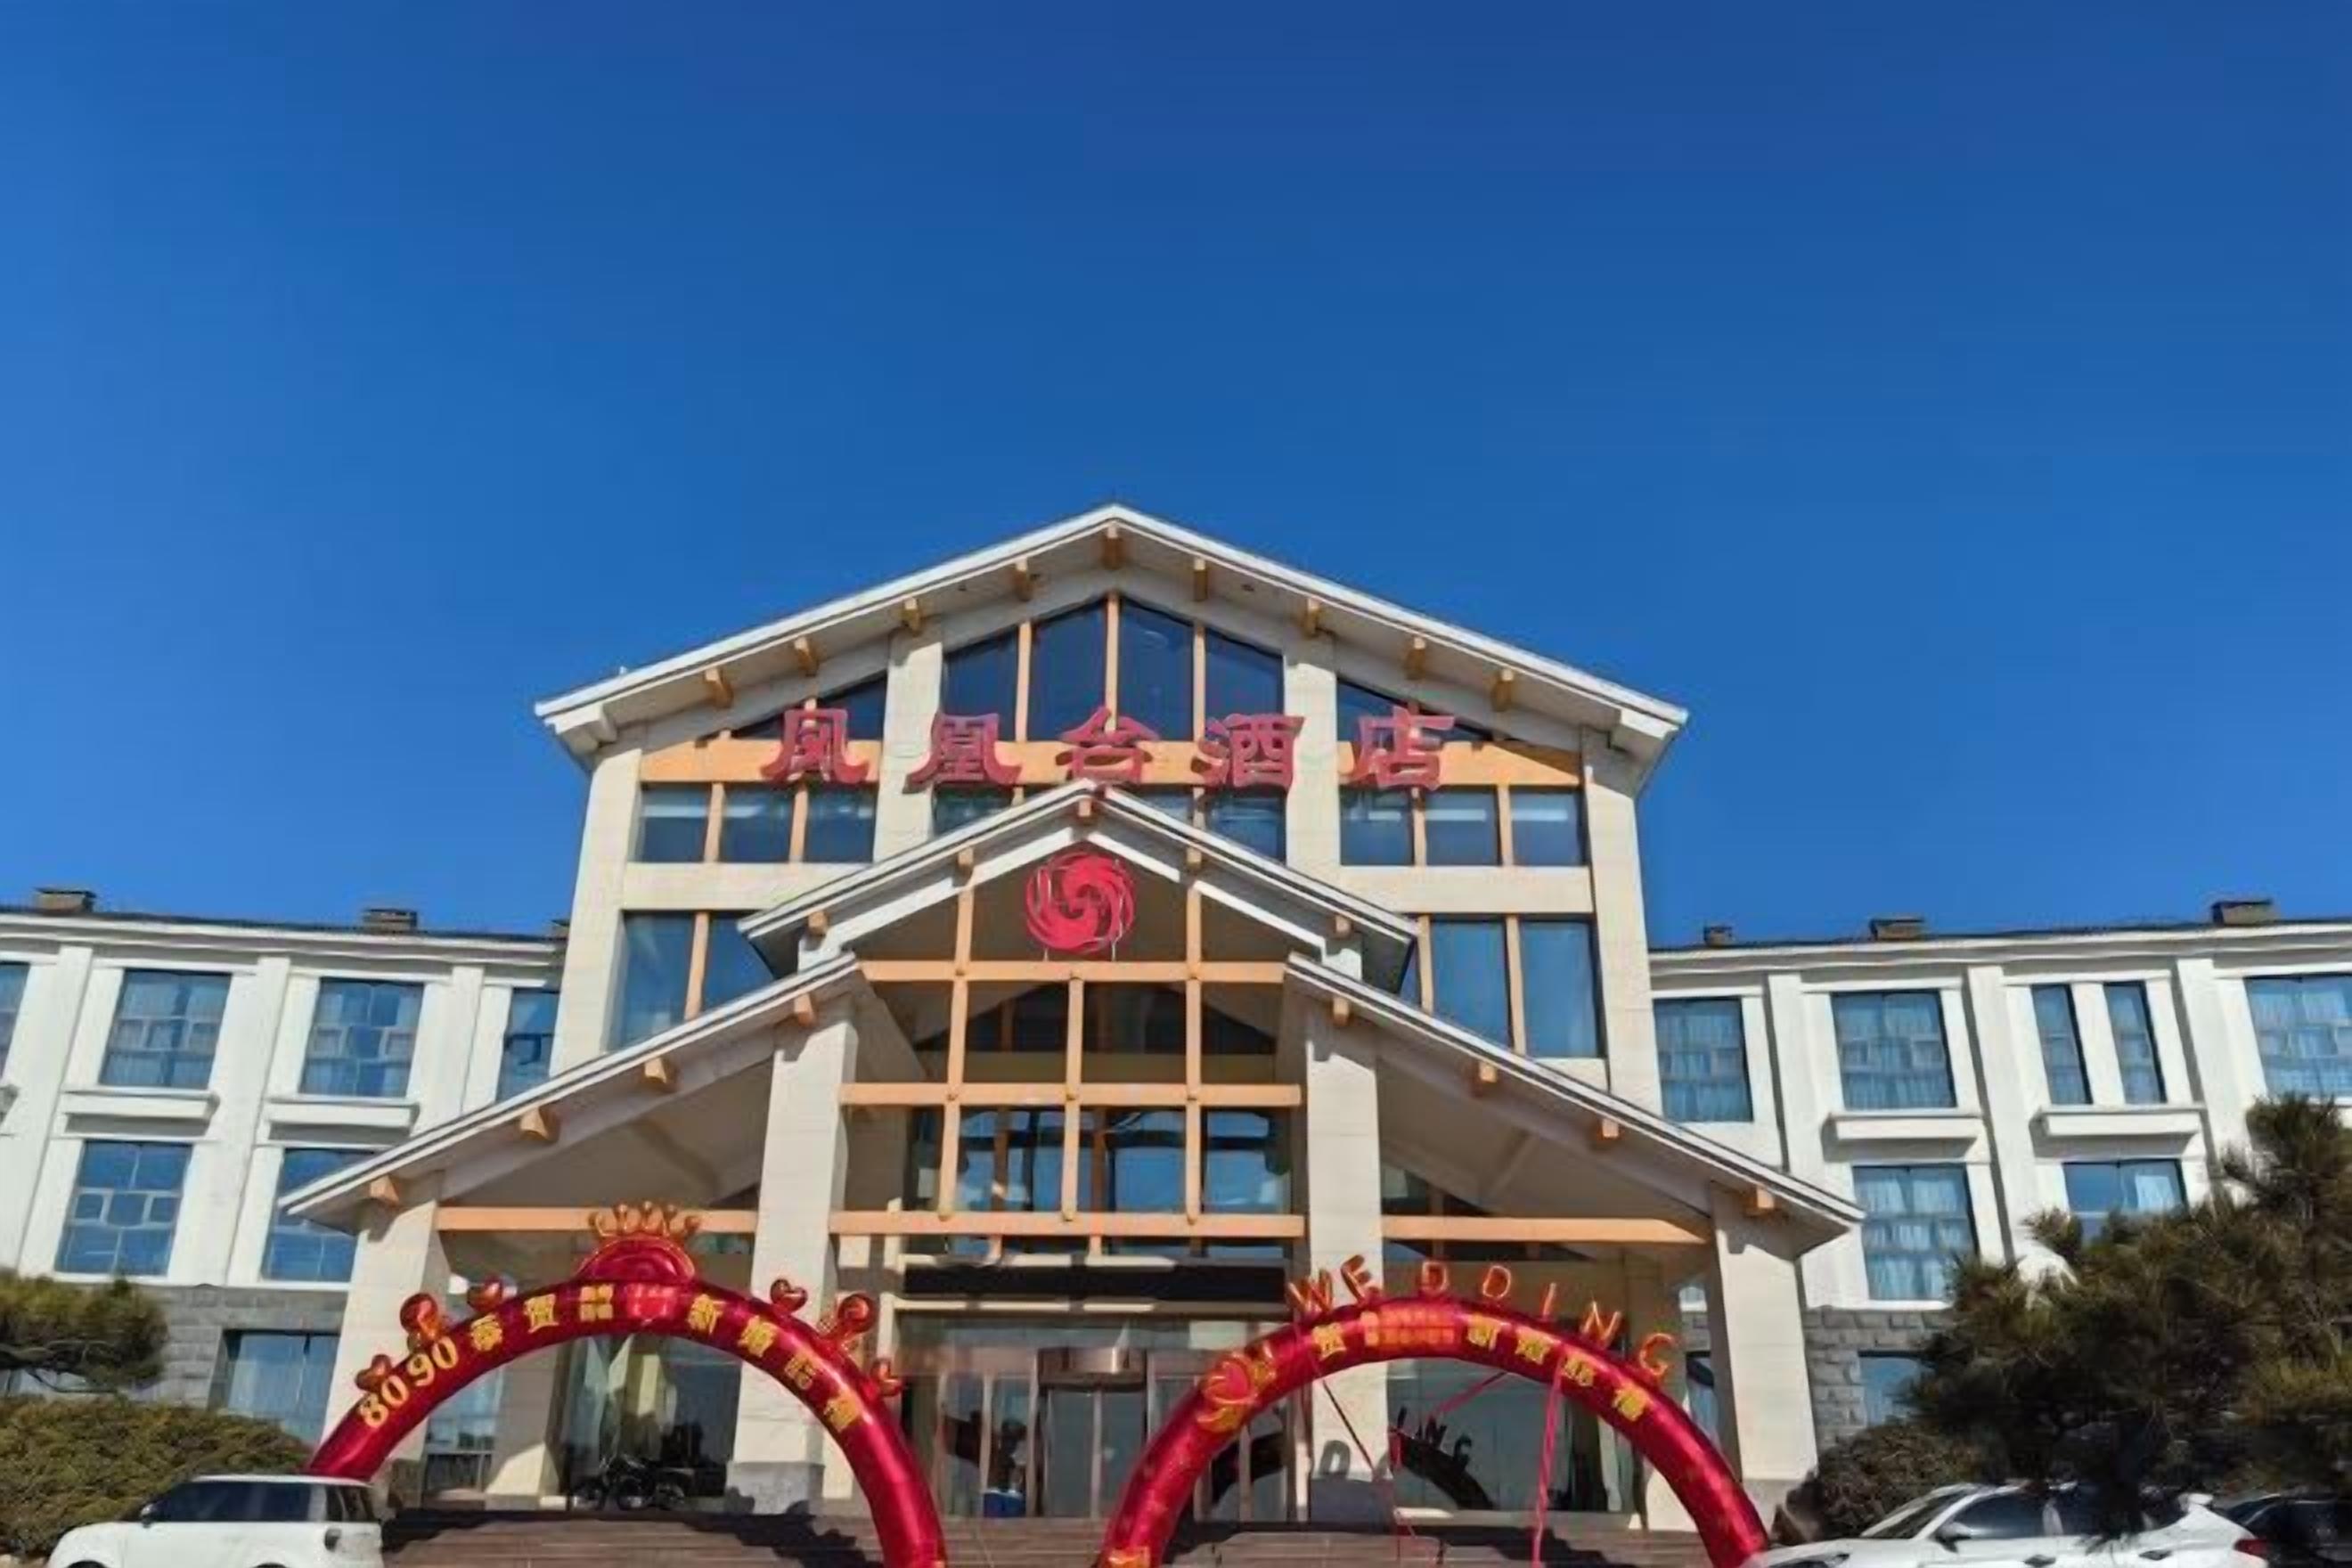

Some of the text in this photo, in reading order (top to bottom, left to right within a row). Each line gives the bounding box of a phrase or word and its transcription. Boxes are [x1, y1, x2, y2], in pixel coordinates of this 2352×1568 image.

[760, 705, 1455, 794] 凤凰台酒店
[1288, 1254, 1675, 1375] WEDDING
